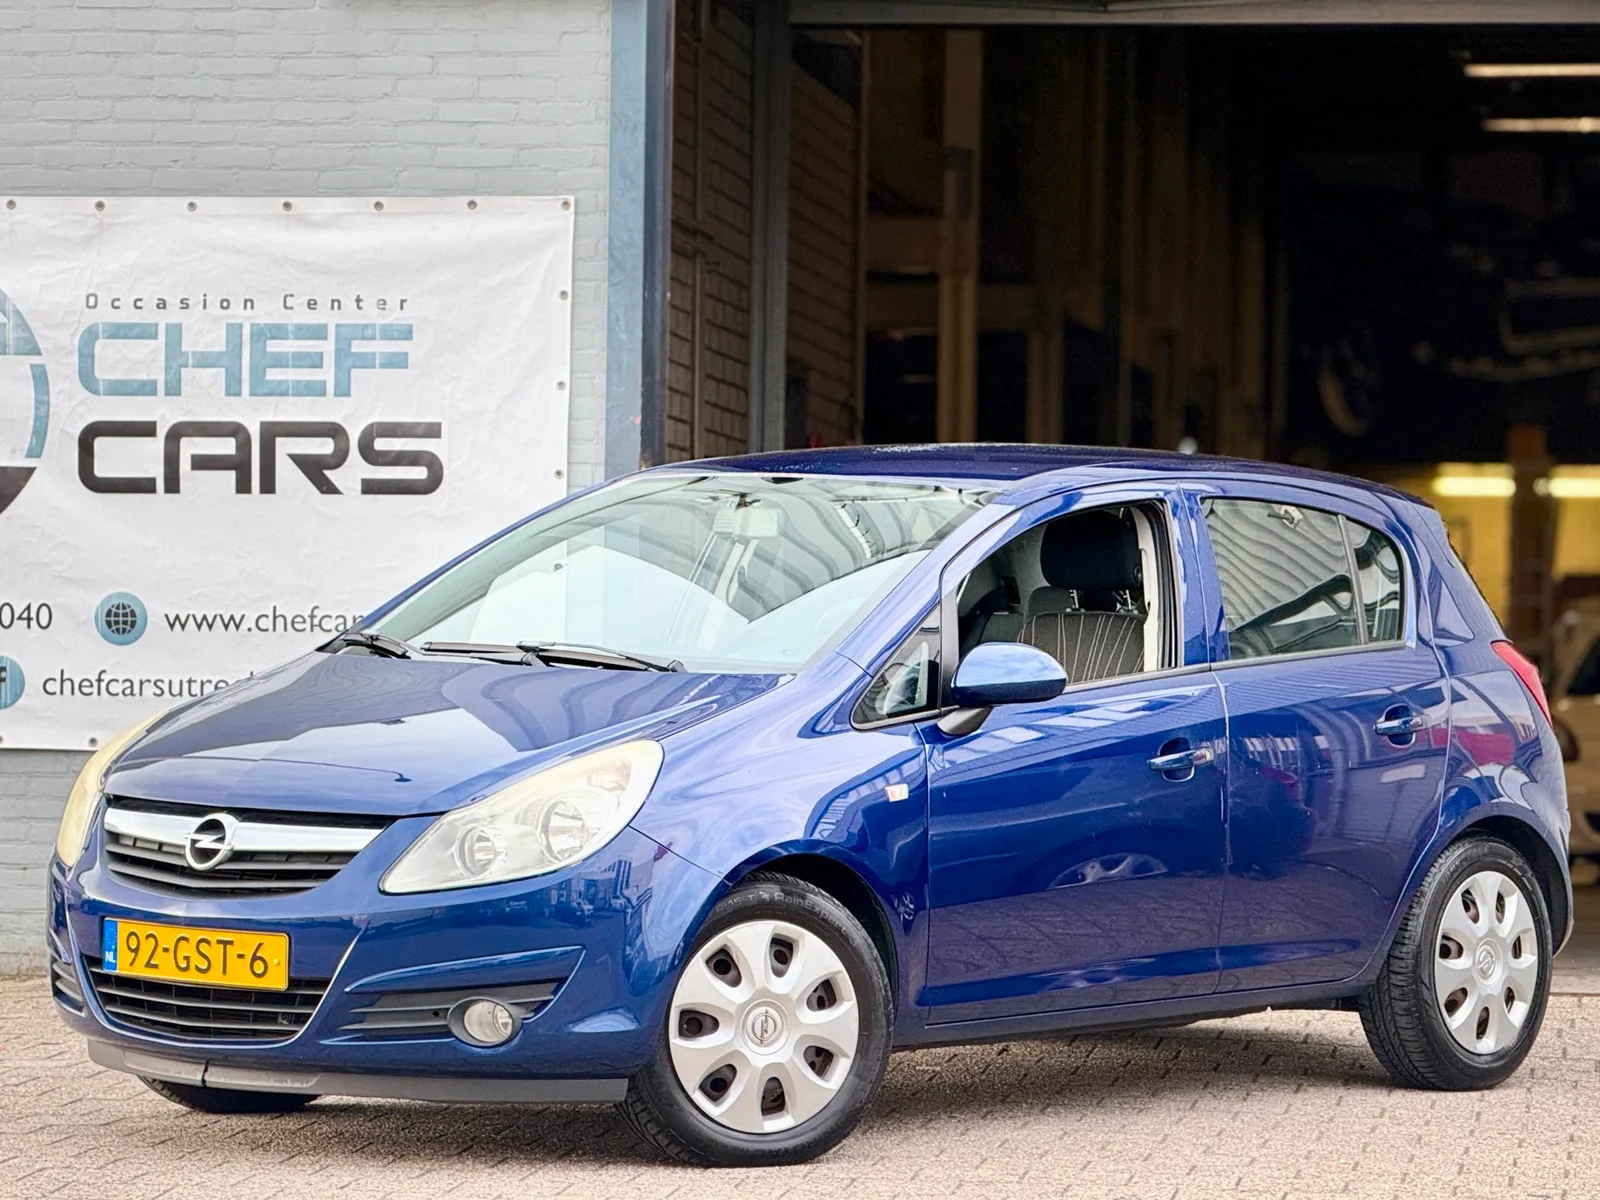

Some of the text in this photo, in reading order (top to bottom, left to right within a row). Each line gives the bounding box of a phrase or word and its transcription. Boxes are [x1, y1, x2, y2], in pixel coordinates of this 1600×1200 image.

[85, 293, 408, 311] Occasion Center
[78, 322, 414, 397] CHEF
[78, 420, 444, 495] CARS
[774, 892, 847, 935] RainExpert
[104, 950, 116, 963] NL
[126, 931, 268, 978] 92-GST-6
